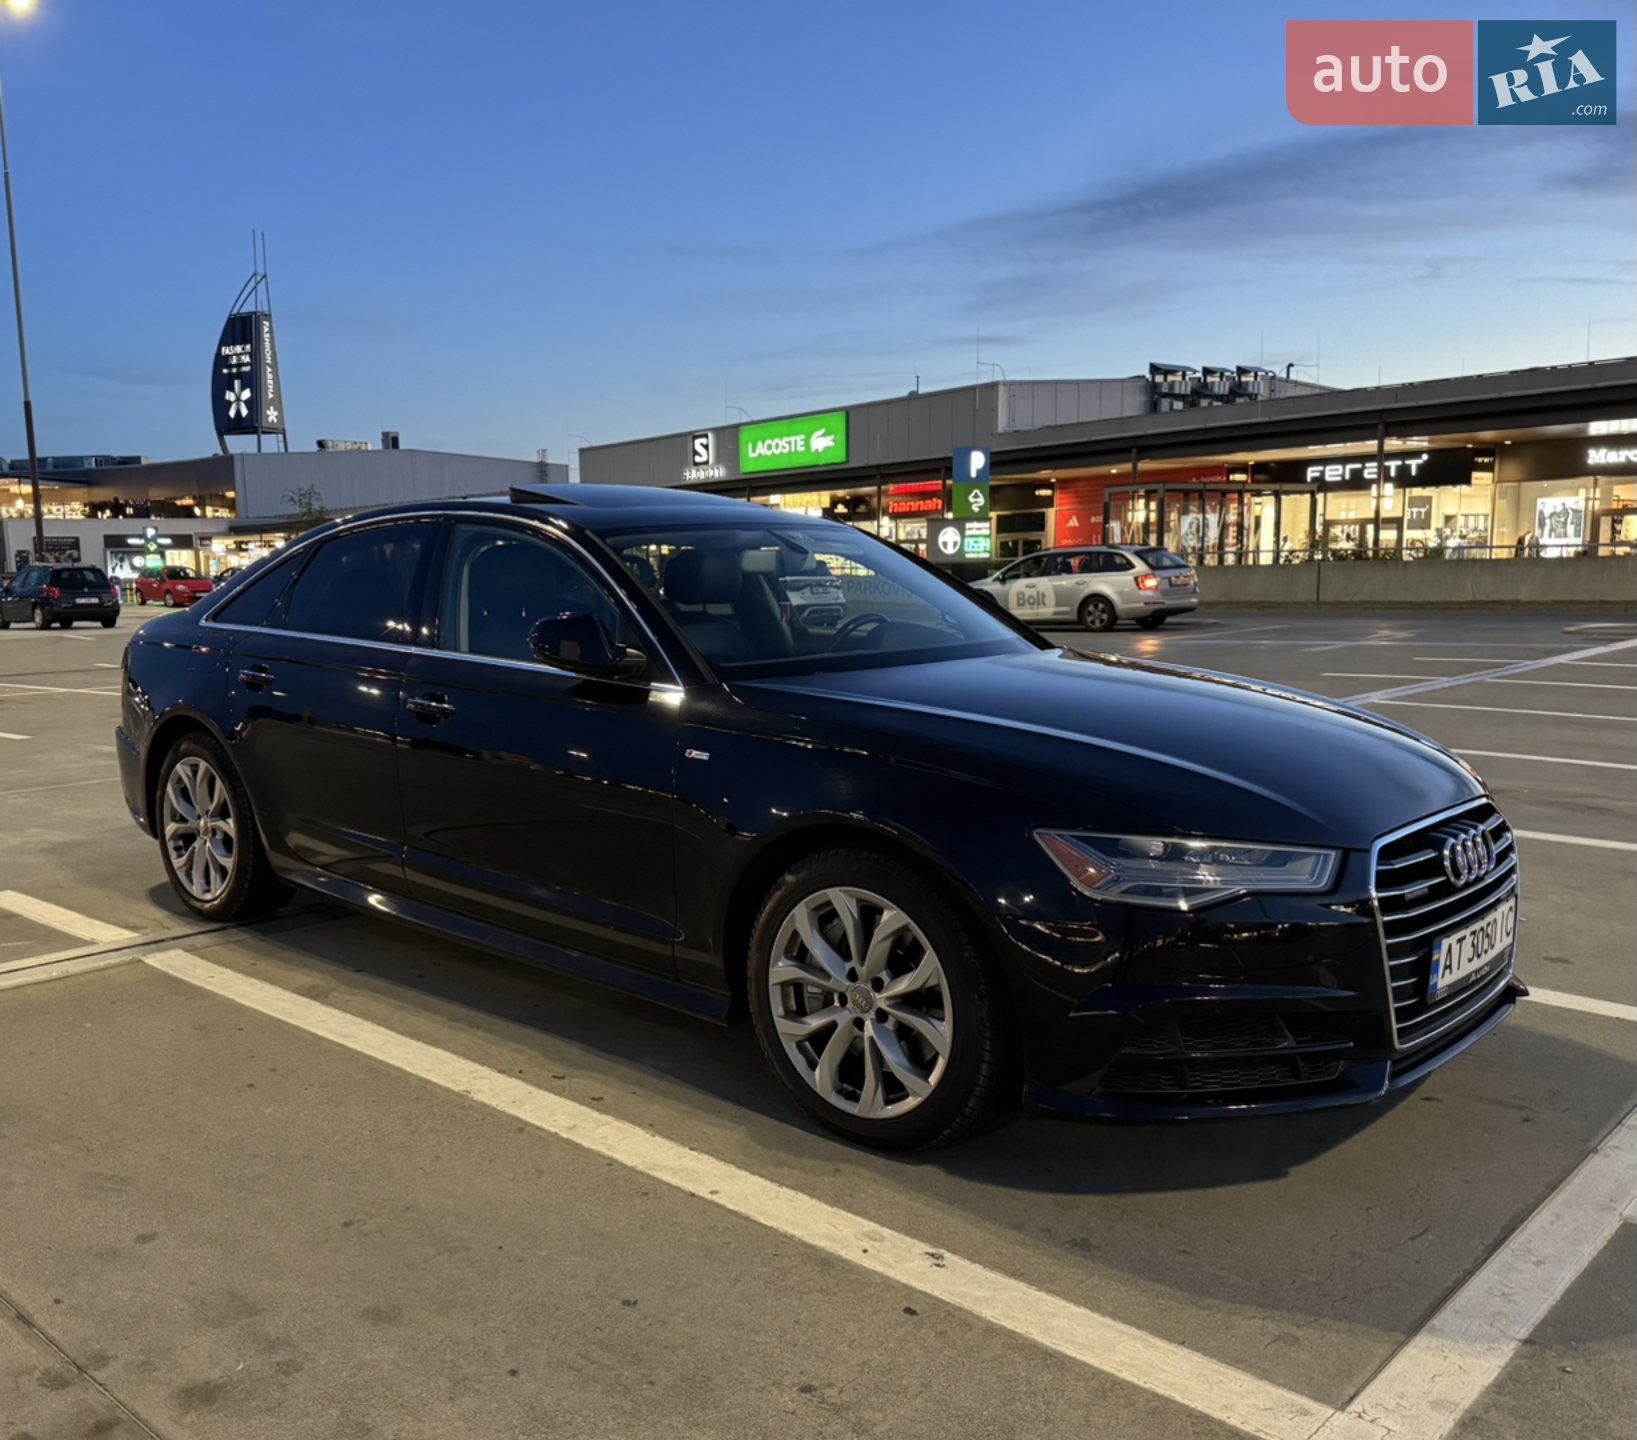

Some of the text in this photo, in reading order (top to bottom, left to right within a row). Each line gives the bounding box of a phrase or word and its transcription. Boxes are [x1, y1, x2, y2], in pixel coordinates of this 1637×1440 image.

[221, 344, 251, 355] FASHION
[262, 320, 275, 400] FASHION ARENA
[748, 434, 806, 458] LACOSTE
[970, 450, 986, 478] P
[888, 498, 943, 514] hannah
[1016, 591, 1047, 607] Bolt
[1441, 905, 1513, 980] AT 3050 IC
[1469, 965, 1490, 983] Audi
